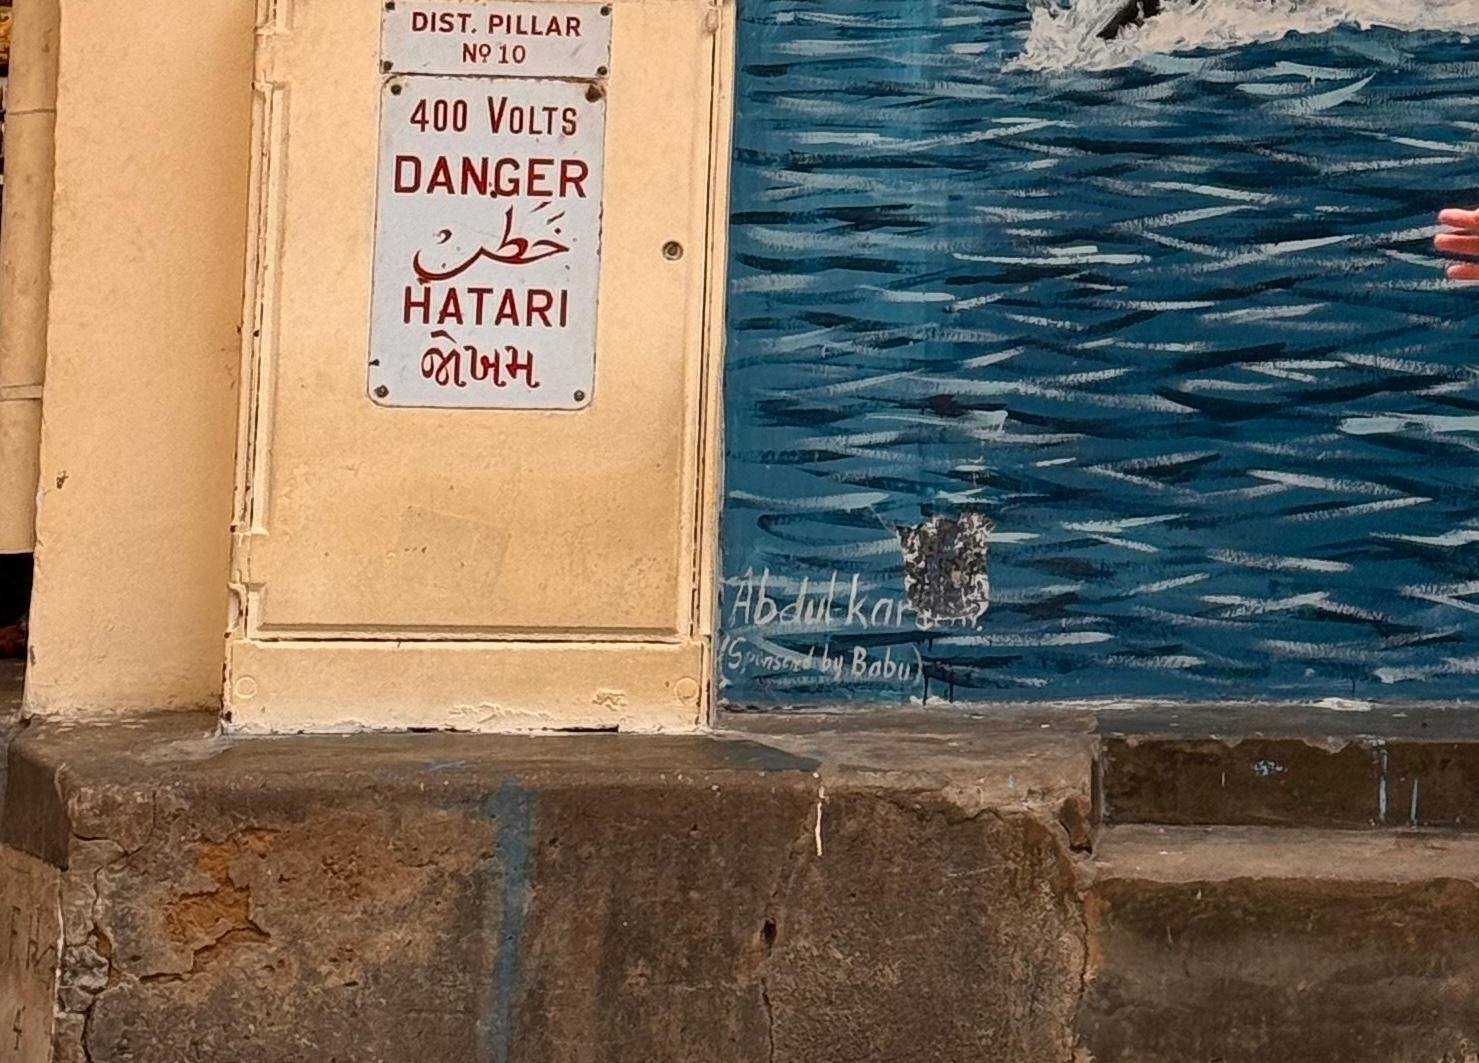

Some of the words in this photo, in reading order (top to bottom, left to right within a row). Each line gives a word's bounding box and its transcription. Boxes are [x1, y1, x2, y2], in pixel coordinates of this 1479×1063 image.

[410, 11, 477, 35] DIST.
[488, 13, 582, 37] PILLAR
[499, 43, 527, 64] 10
[408, 98, 468, 133] 400
[392, 154, 590, 198] DANGER
[402, 285, 569, 328] HATARI
[820, 642, 845, 681] by
[852, 641, 923, 683] Babu)
